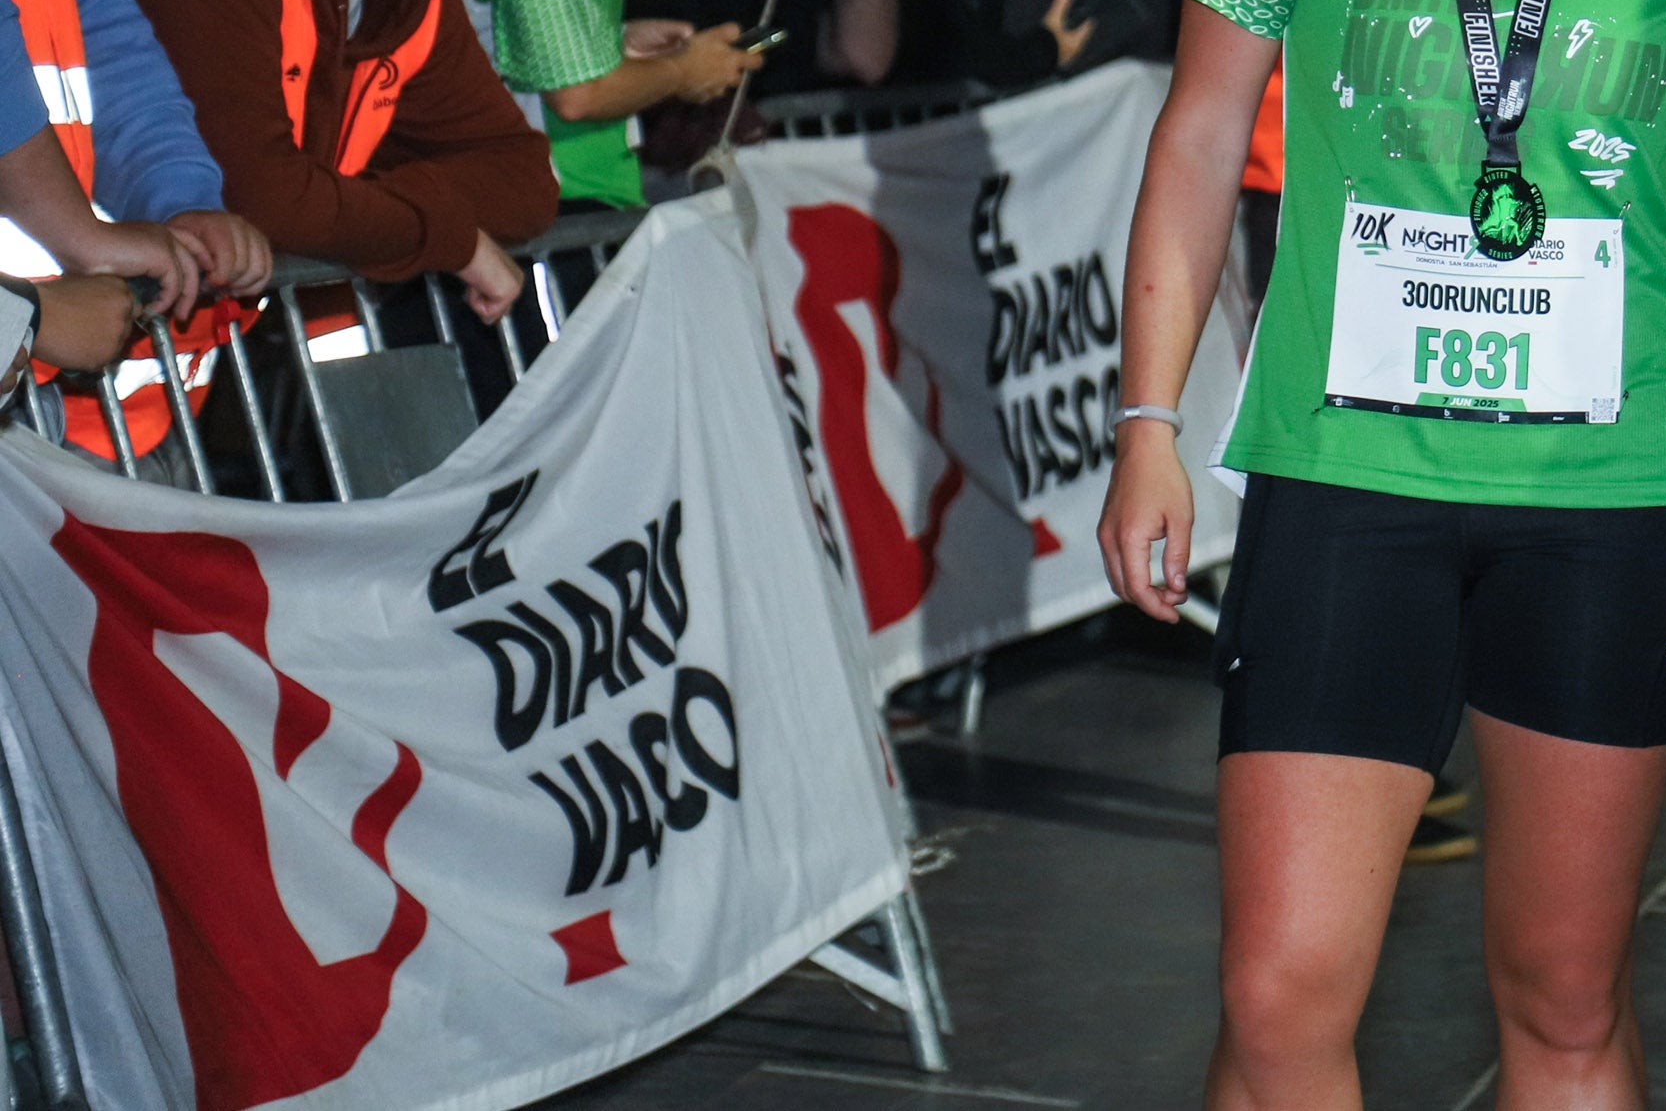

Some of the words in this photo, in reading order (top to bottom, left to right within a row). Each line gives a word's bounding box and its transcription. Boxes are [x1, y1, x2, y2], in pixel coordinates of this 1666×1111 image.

[1568, 128, 1637, 164] 2025
[970, 171, 1018, 276] EL
[1351, 212, 1395, 249] 10K
[1528, 250, 1564, 261] VASCO
[1594, 240, 1611, 268] 4
[1402, 280, 1551, 315] 300RUNCLUB
[985, 249, 1116, 386] DIARIO
[1414, 326, 1531, 390] F831
[1442, 397, 1449, 405] 7
[1450, 397, 1472, 407] JUN
[1473, 398, 1500, 408] 2025
[427, 467, 540, 613] EL
[528, 666, 740, 898] VACO
